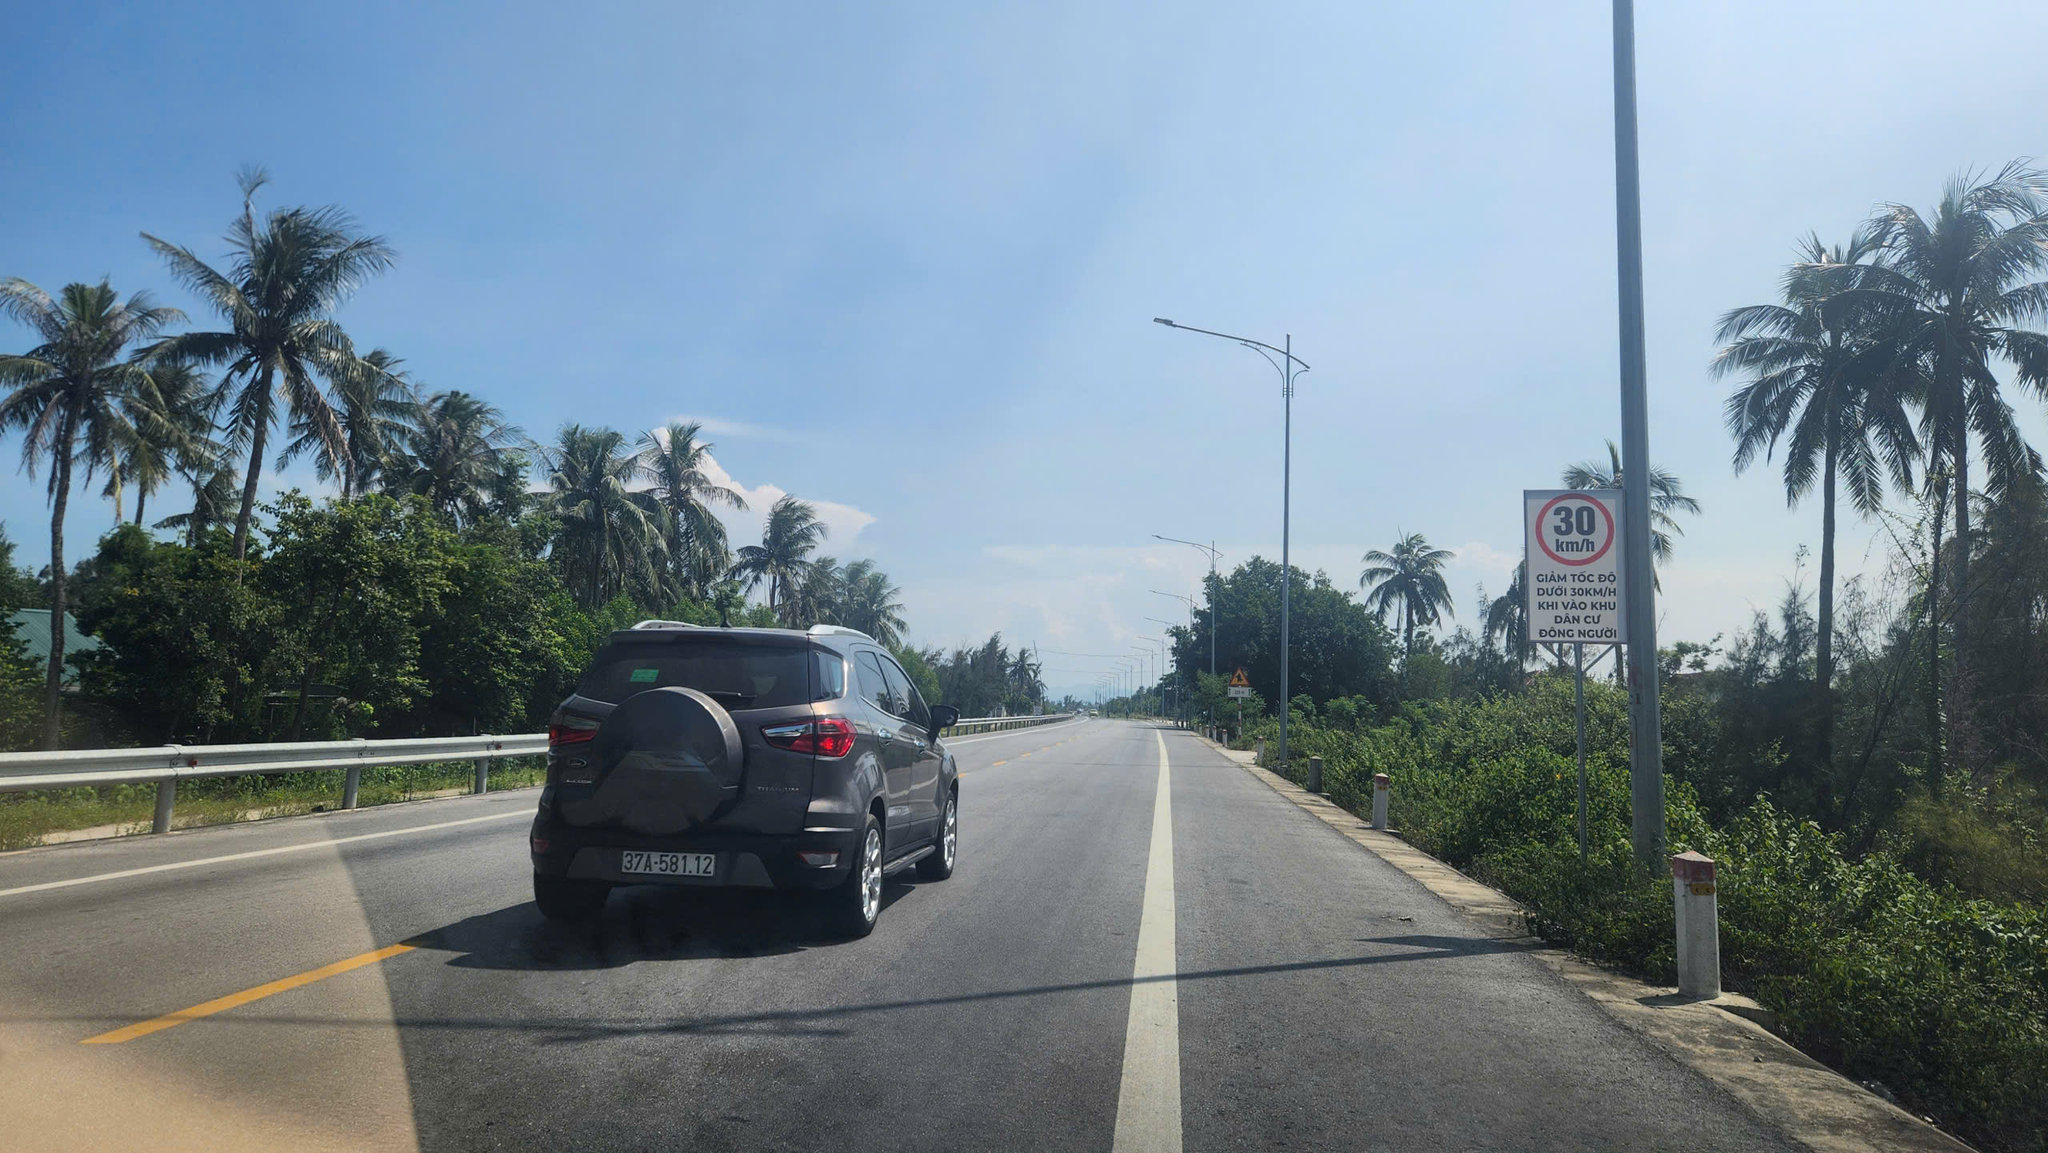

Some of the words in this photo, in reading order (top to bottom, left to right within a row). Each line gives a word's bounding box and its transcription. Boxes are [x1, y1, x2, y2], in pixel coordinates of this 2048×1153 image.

[1553, 506, 1596, 536] 30
[1555, 538, 1595, 552] km/h
[1536, 570, 1567, 583] GIẢM
[1570, 570, 1595, 583] TỐC
[1597, 571, 1617, 585] ĐỘ
[1537, 585, 1567, 597] DƯỚI
[1570, 586, 1617, 598] 30KM/H
[1538, 601, 1558, 610] KHI
[1562, 599, 1587, 610] VÀO
[1591, 601, 1616, 610] KHU
[1554, 612, 1580, 624] DÂN
[1583, 613, 1601, 624] CƯ
[1538, 626, 1575, 638] ĐÔNG
[1577, 627, 1617, 639] NGƯỜI
[623, 852, 713, 875] 37A-581.12
